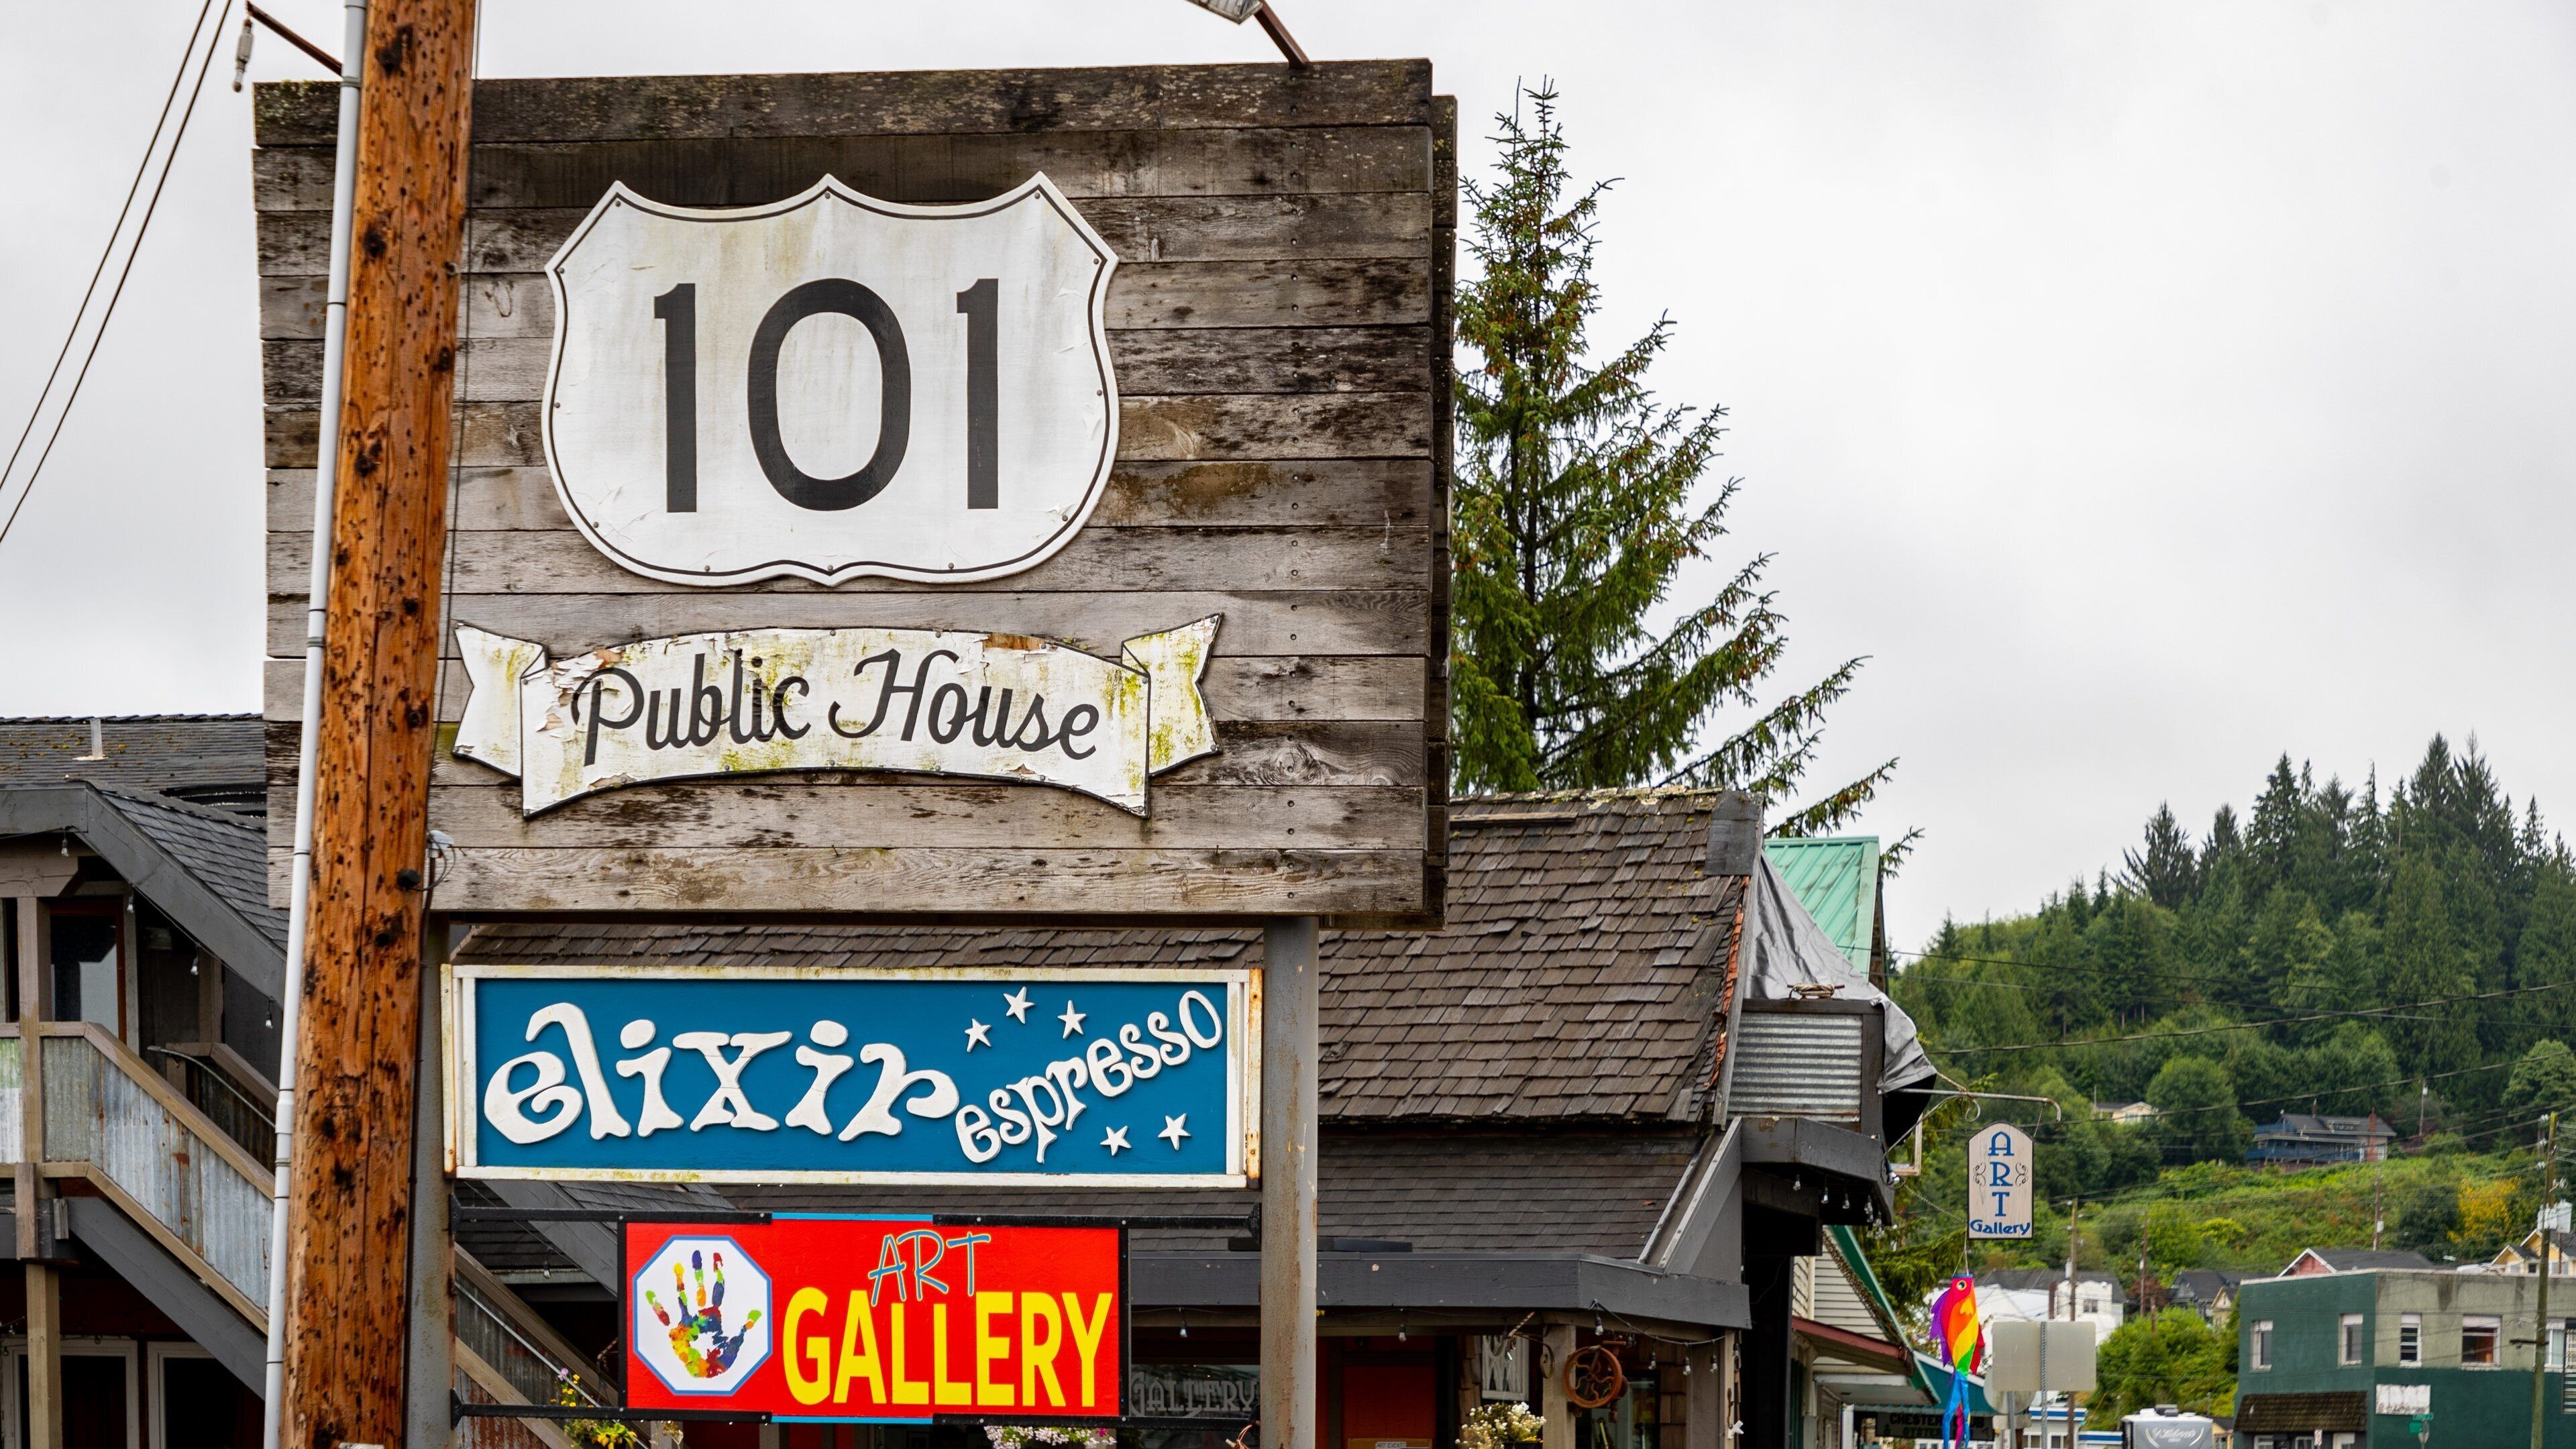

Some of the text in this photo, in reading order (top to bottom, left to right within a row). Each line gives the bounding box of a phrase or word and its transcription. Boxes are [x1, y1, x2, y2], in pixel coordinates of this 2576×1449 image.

[654, 278, 999, 513] 101
[572, 647, 1099, 766] Public House
[483, 989, 1224, 1164] elixir espresso
[1988, 1131, 2015, 1216] ART
[867, 1229, 991, 1307] ART
[1970, 1219, 2031, 1235] Gallery
[782, 1286, 1114, 1407] GALLERY
[1131, 1371, 1259, 1417] GALLERY
